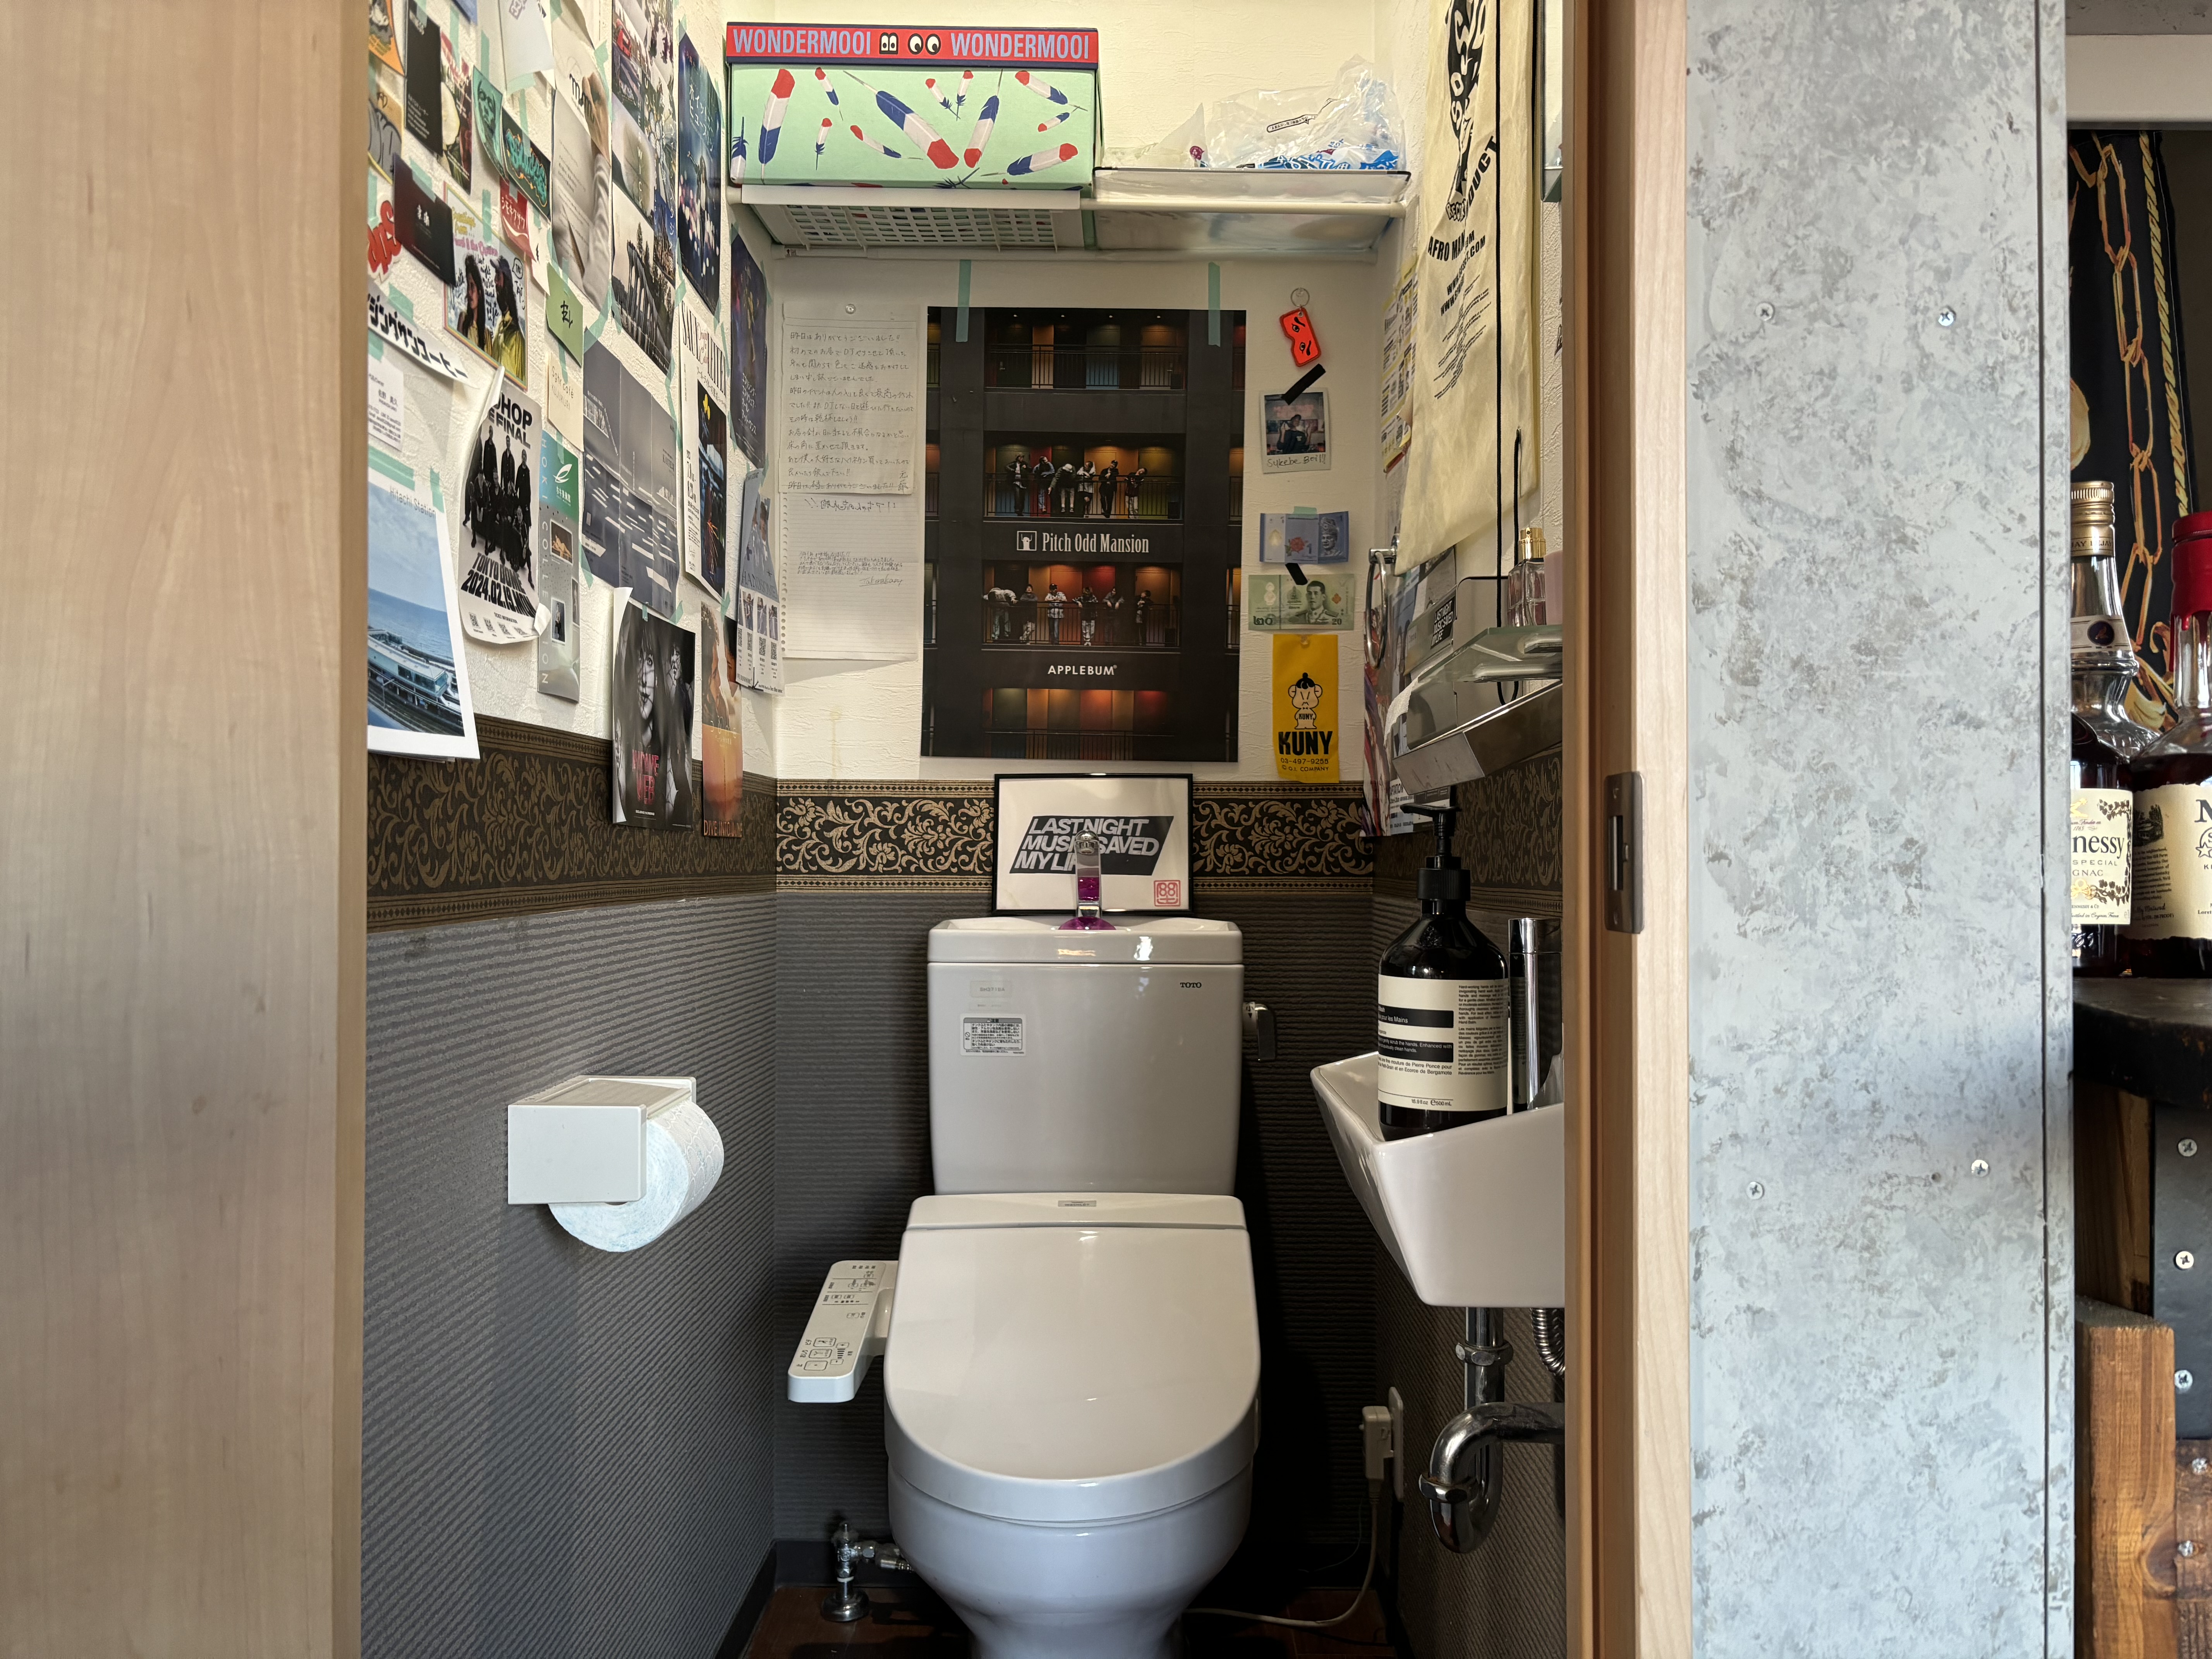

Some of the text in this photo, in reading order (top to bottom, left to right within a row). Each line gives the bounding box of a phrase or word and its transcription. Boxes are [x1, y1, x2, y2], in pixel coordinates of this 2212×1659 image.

[733, 29, 871, 55] WONDERMOOI
[951, 33, 1089, 59] WONDERMOOI
[1427, 235, 1449, 261] AFRO
[496, 411, 531, 450] FINAL
[390, 485, 436, 519] Hitachi Station
[1042, 533, 1149, 553] Pitch Odd Mansion
[472, 552, 527, 595] TOKYO DOME
[1278, 731, 1333, 756] KUNY
[636, 774, 655, 805] WEB
[704, 819, 717, 836] DIVE
[719, 821, 730, 836] INTO
[1028, 818, 1149, 836] LAST NIGHT
[1022, 835, 1076, 853] MUSI
[2073, 835, 2124, 859] nessy
[1014, 852, 1052, 870] MY
